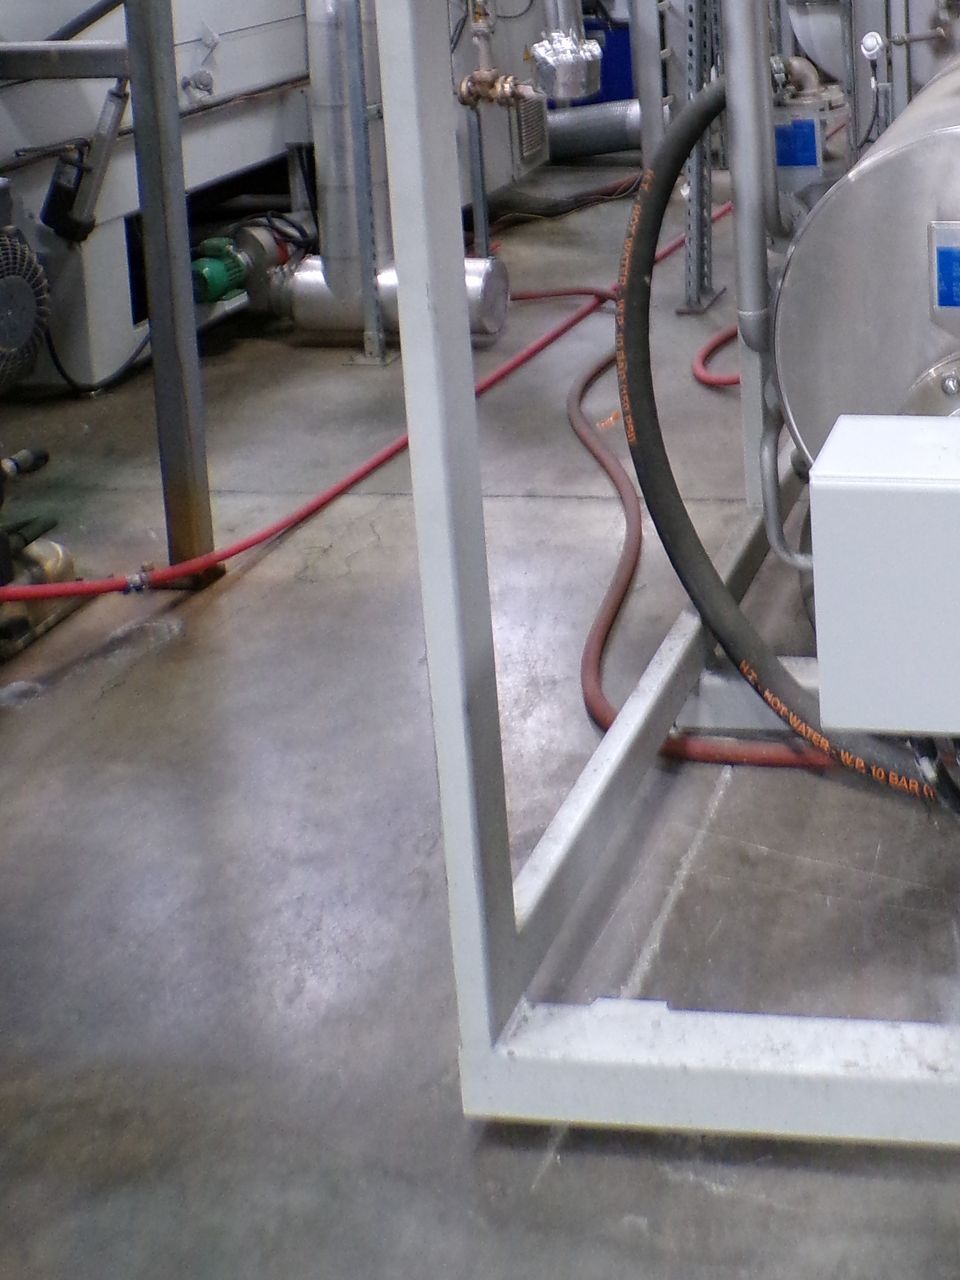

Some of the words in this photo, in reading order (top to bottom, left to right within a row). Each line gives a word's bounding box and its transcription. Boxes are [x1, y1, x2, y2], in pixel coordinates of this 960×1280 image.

[619, 238, 634, 288] WATER
[763, 688, 788, 716] HOT
[789, 712, 831, 752] WATER
[871, 765, 886, 783] 10
[888, 771, 920, 799] BAR
